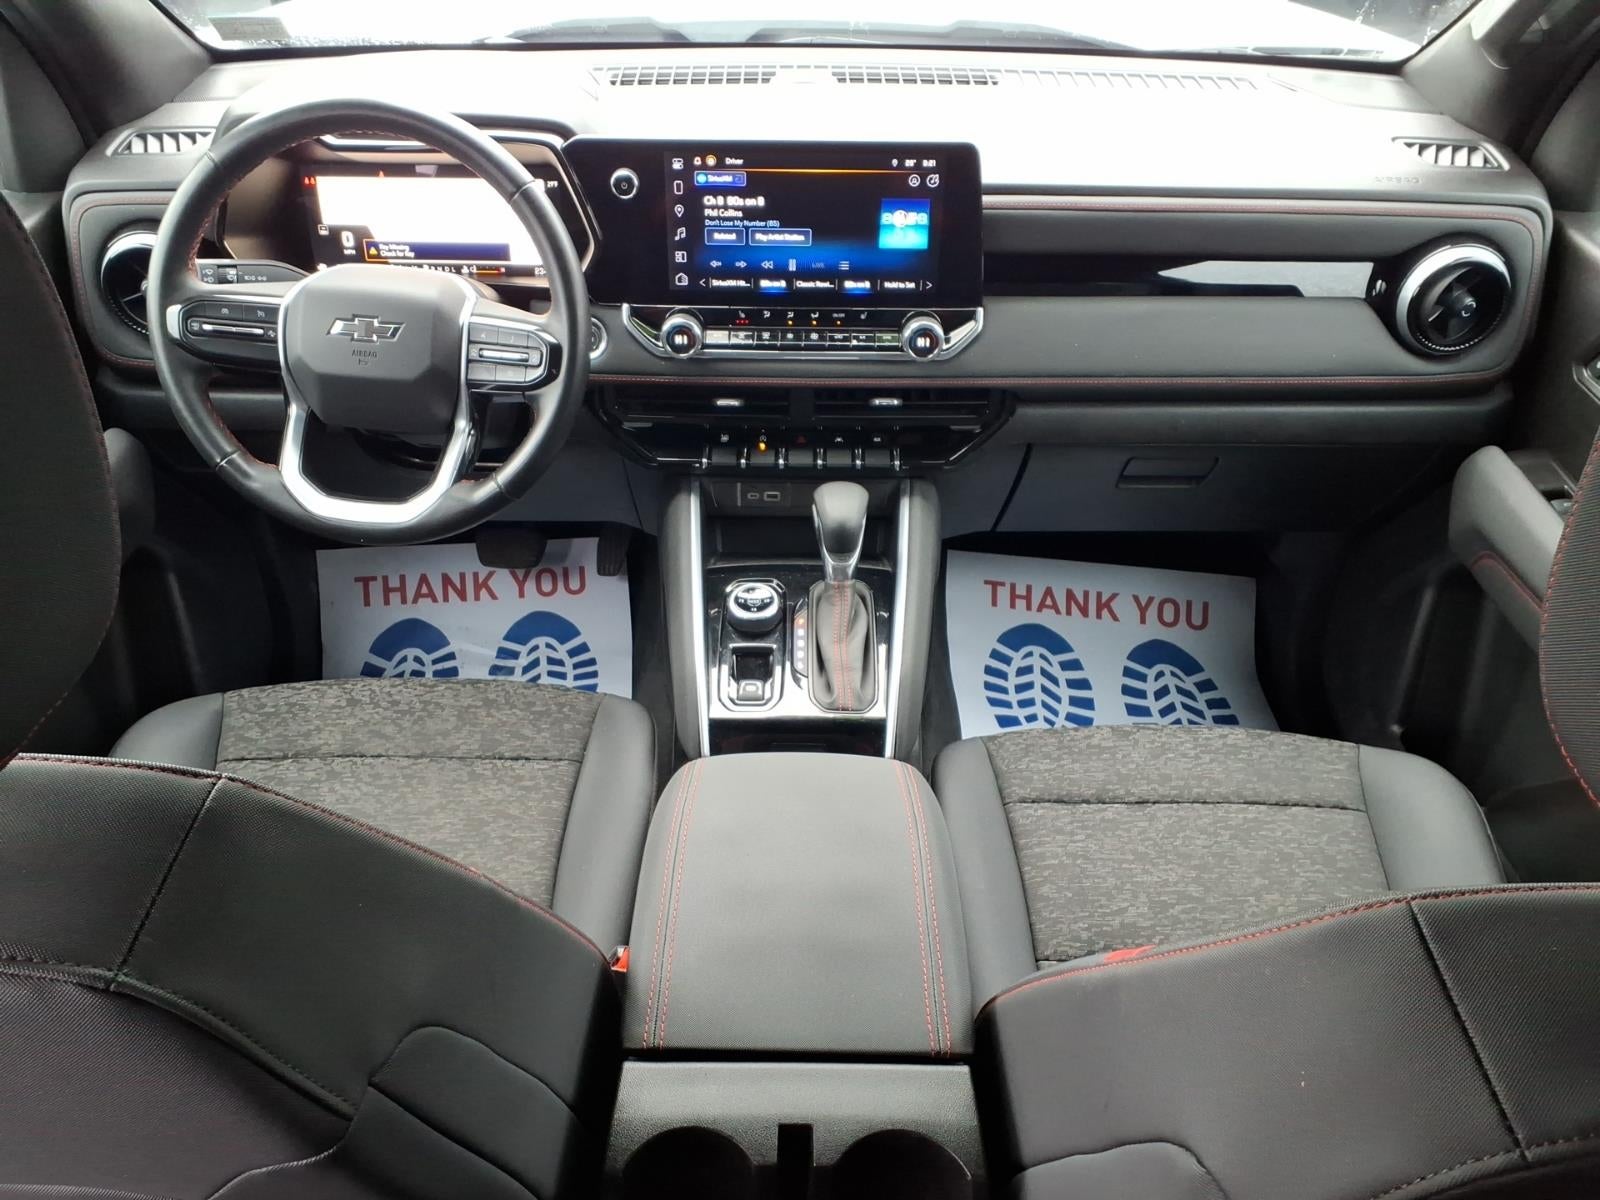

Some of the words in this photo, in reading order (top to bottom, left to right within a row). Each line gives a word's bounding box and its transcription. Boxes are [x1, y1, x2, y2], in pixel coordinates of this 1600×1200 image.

[725, 157, 744, 165] Driver
[703, 195, 716, 206] Ch
[745, 197, 757, 207] on
[704, 208, 718, 217] Phil
[719, 209, 743, 218] Collins
[735, 220, 743, 228] My
[743, 220, 766, 228] Number
[351, 348, 378, 358] AIRBAG
[354, 570, 500, 608] THANK
[508, 565, 588, 600] YOU
[983, 579, 1121, 623] THANK
[1131, 593, 1210, 632] YOU
